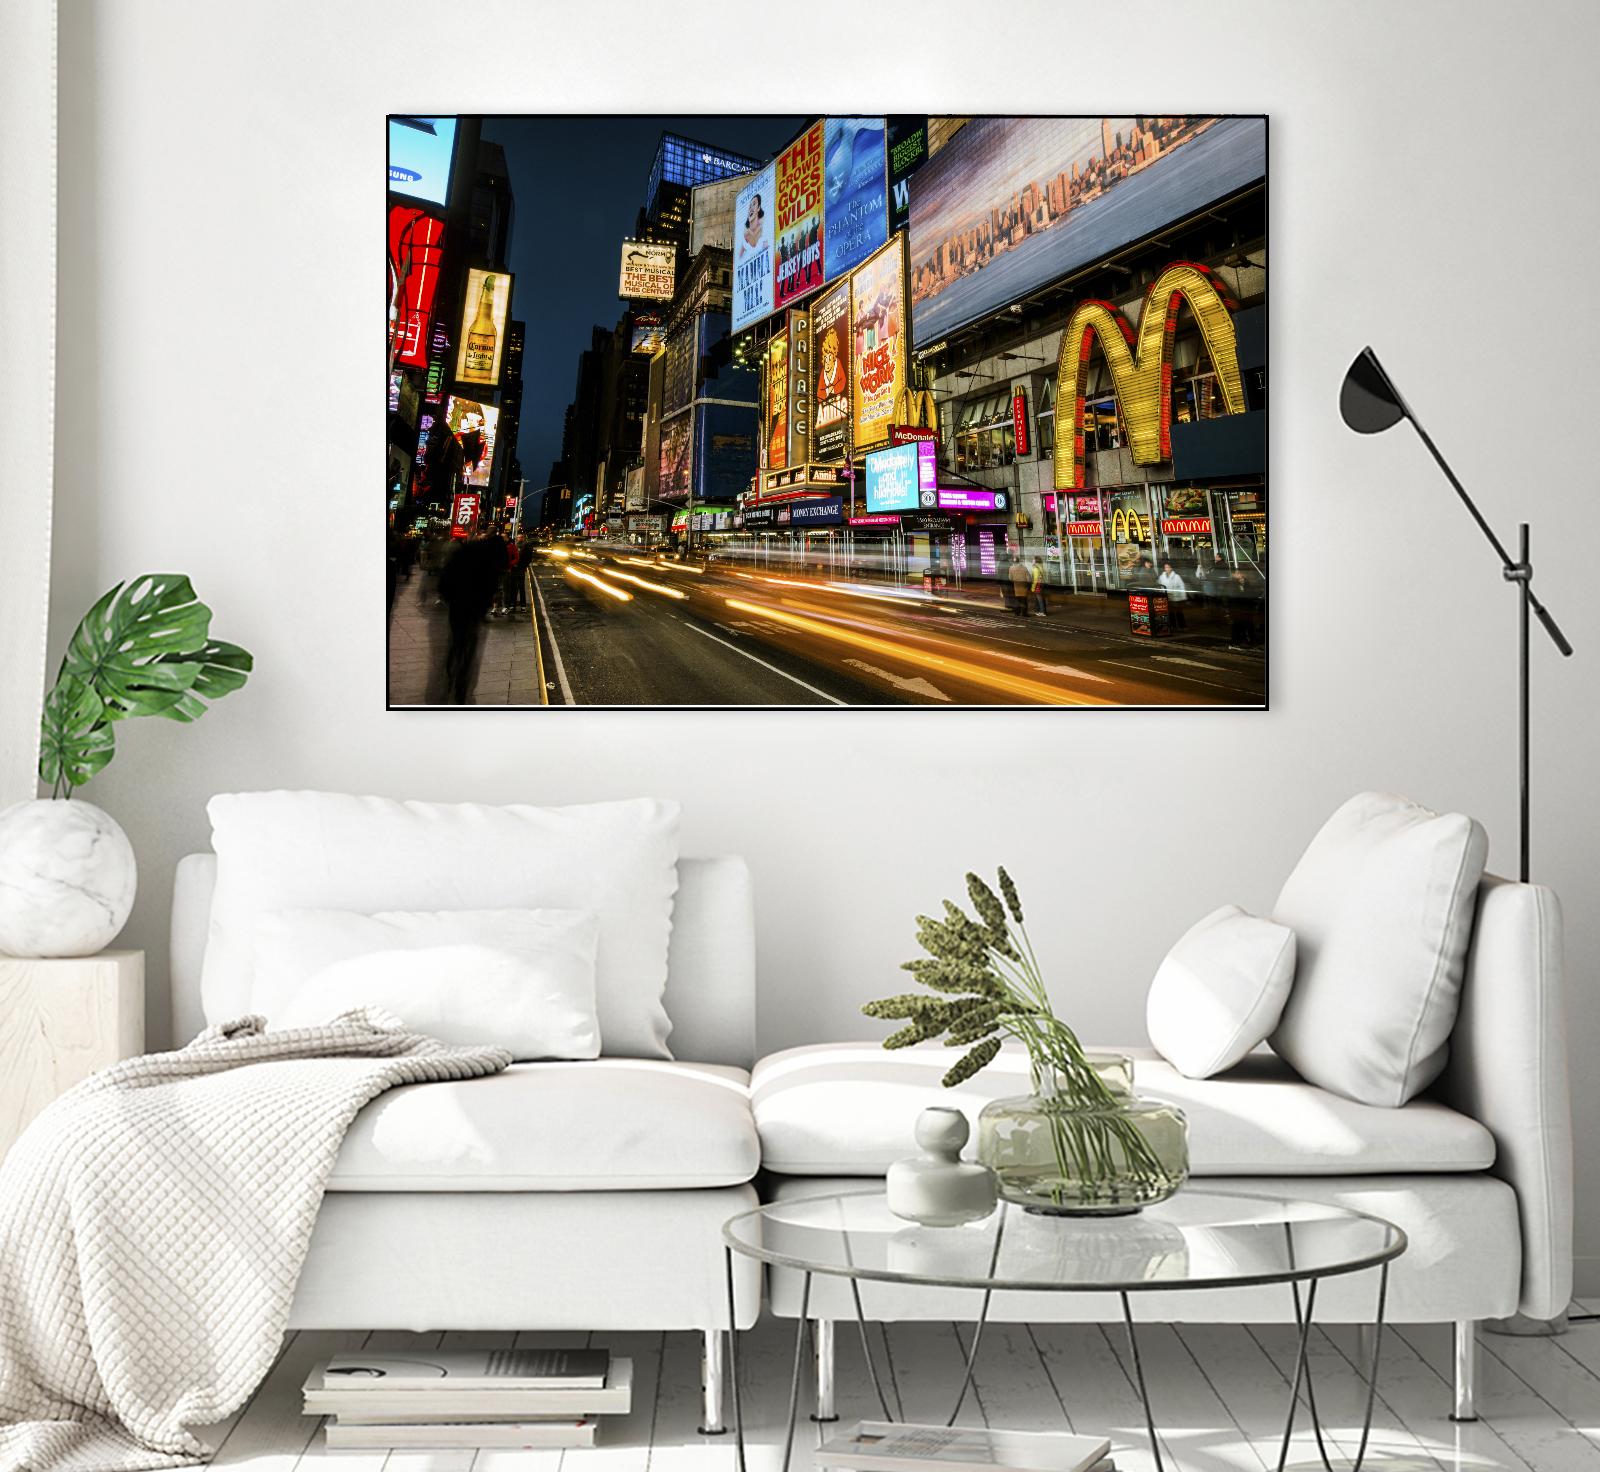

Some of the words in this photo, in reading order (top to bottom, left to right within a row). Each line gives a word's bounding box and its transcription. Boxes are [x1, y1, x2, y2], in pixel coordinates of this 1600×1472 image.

[778, 124, 821, 178] THE
[778, 151, 821, 194] CROWD
[778, 166, 821, 212] GOES
[778, 184, 821, 231] WILD!
[827, 193, 883, 239] PHANTOM
[836, 229, 872, 258] OPERA
[644, 268, 676, 276] MUSICAL
[777, 252, 801, 283] JERSEY
[802, 240, 821, 268] BOYS
[624, 280, 661, 289] MUSICAL
[662, 282, 675, 290] OF
[626, 272, 647, 282] THE
[648, 274, 675, 284] BEST
[641, 287, 674, 296] CENTURY
[863, 342, 890, 374] NICE
[797, 319, 807, 435] PALACE
[859, 361, 896, 394] WORK
[816, 396, 848, 427] Annie
[812, 468, 837, 481] Annie
[457, 497, 474, 525] tkts
[792, 508, 809, 518] MONEY
[810, 505, 839, 517] EXCHANGE
